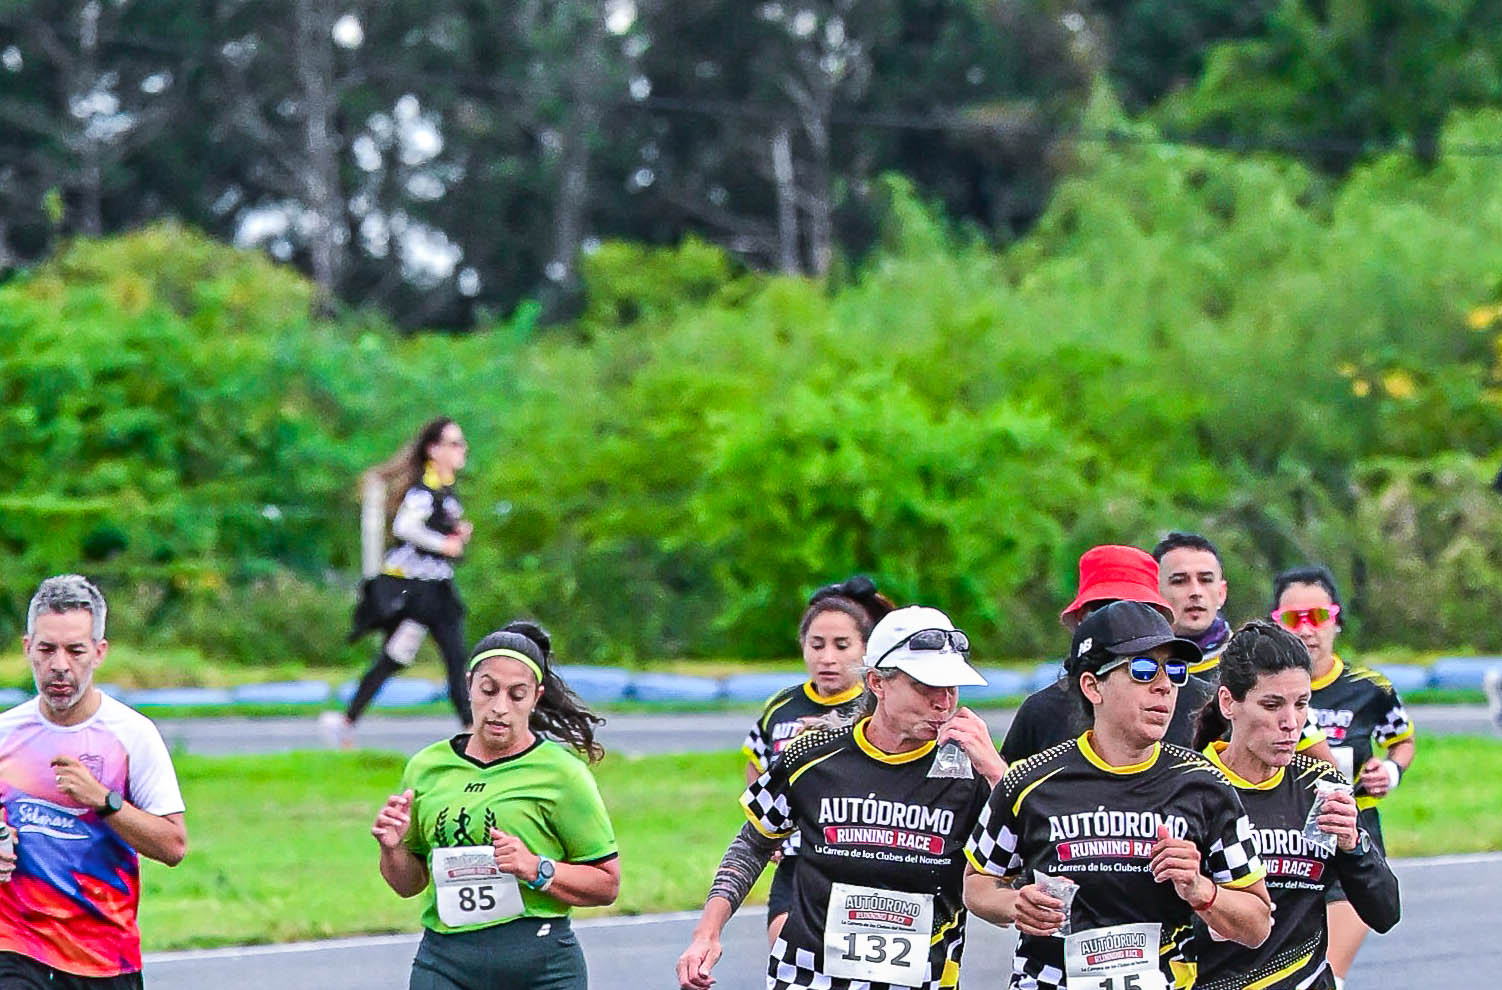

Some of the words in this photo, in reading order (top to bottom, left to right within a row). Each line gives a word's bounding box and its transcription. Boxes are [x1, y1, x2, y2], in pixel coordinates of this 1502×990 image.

[818, 792, 955, 836] AUTÓDROMO
[1049, 805, 1189, 842] AUTÓDROMO
[837, 828, 894, 844] RUNNING
[897, 832, 932, 851] RACE
[1069, 840, 1130, 858] RUNNING
[1133, 842, 1156, 858] RA
[823, 846, 850, 857] Carrera
[851, 849, 862, 859] de
[863, 849, 875, 860] los
[876, 851, 904, 863] Clubes
[905, 854, 919, 864] del
[1049, 864, 1057, 873] La
[1057, 863, 1087, 873] Carrera
[1088, 862, 1098, 872] de
[1100, 862, 1112, 872] los
[1113, 862, 1142, 873] Clubes
[1281, 859, 1313, 876] RACE
[458, 885, 496, 912] 85
[845, 893, 921, 918] AUTÓDROMO
[841, 932, 912, 968] 132
[1081, 931, 1147, 955] AUTÓDROMO
